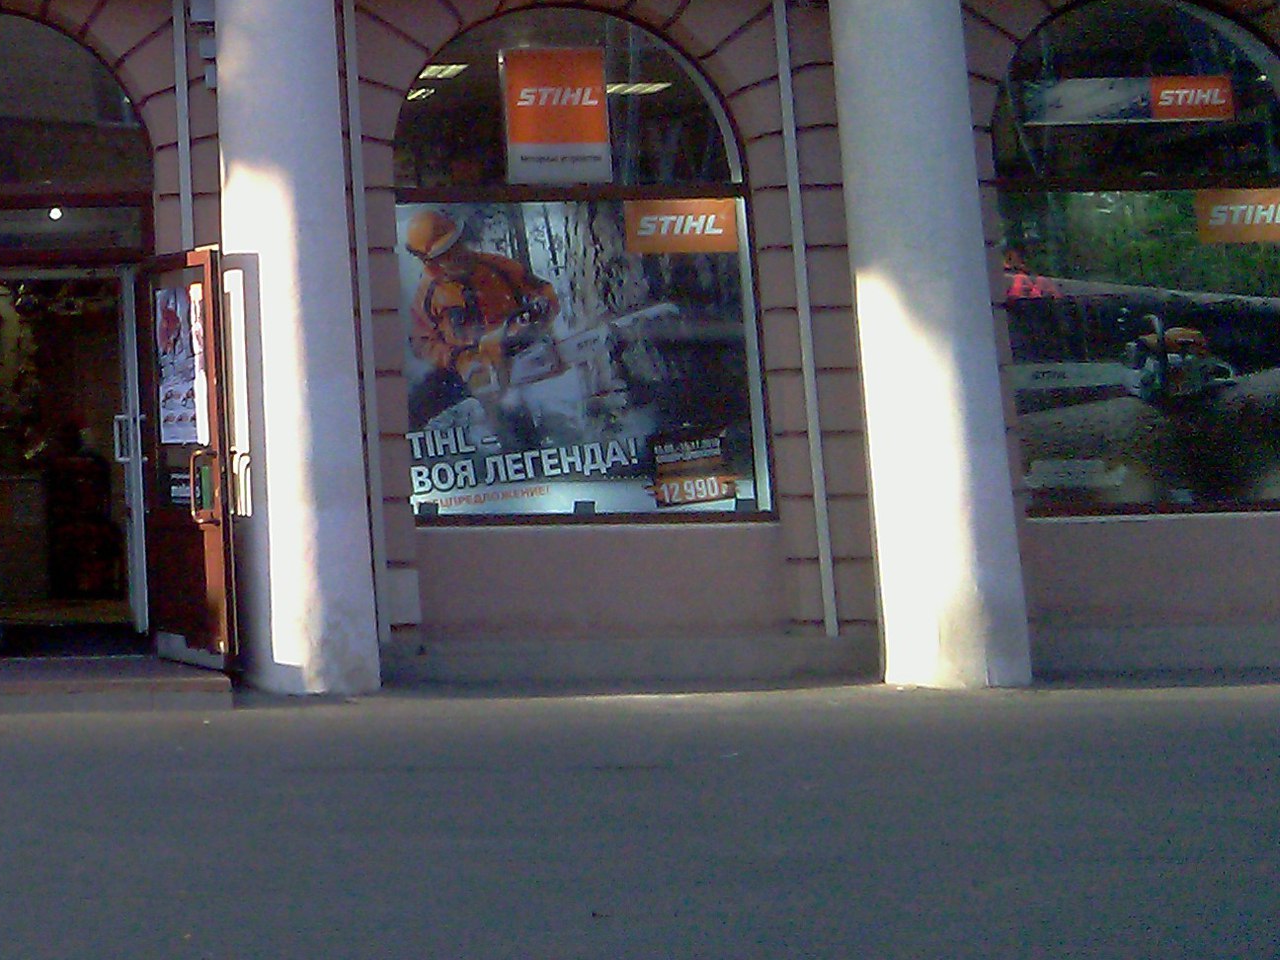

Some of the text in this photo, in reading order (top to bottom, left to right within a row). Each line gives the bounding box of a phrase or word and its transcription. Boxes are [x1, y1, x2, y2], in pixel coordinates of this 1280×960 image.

[517, 87, 598, 107] STIHL
[1158, 88, 1226, 106] STIHL
[637, 214, 723, 235] STIHL
[405, 425, 476, 460] TIHL
[410, 437, 639, 494] ВОЯ ЛЕГЕНДА!
